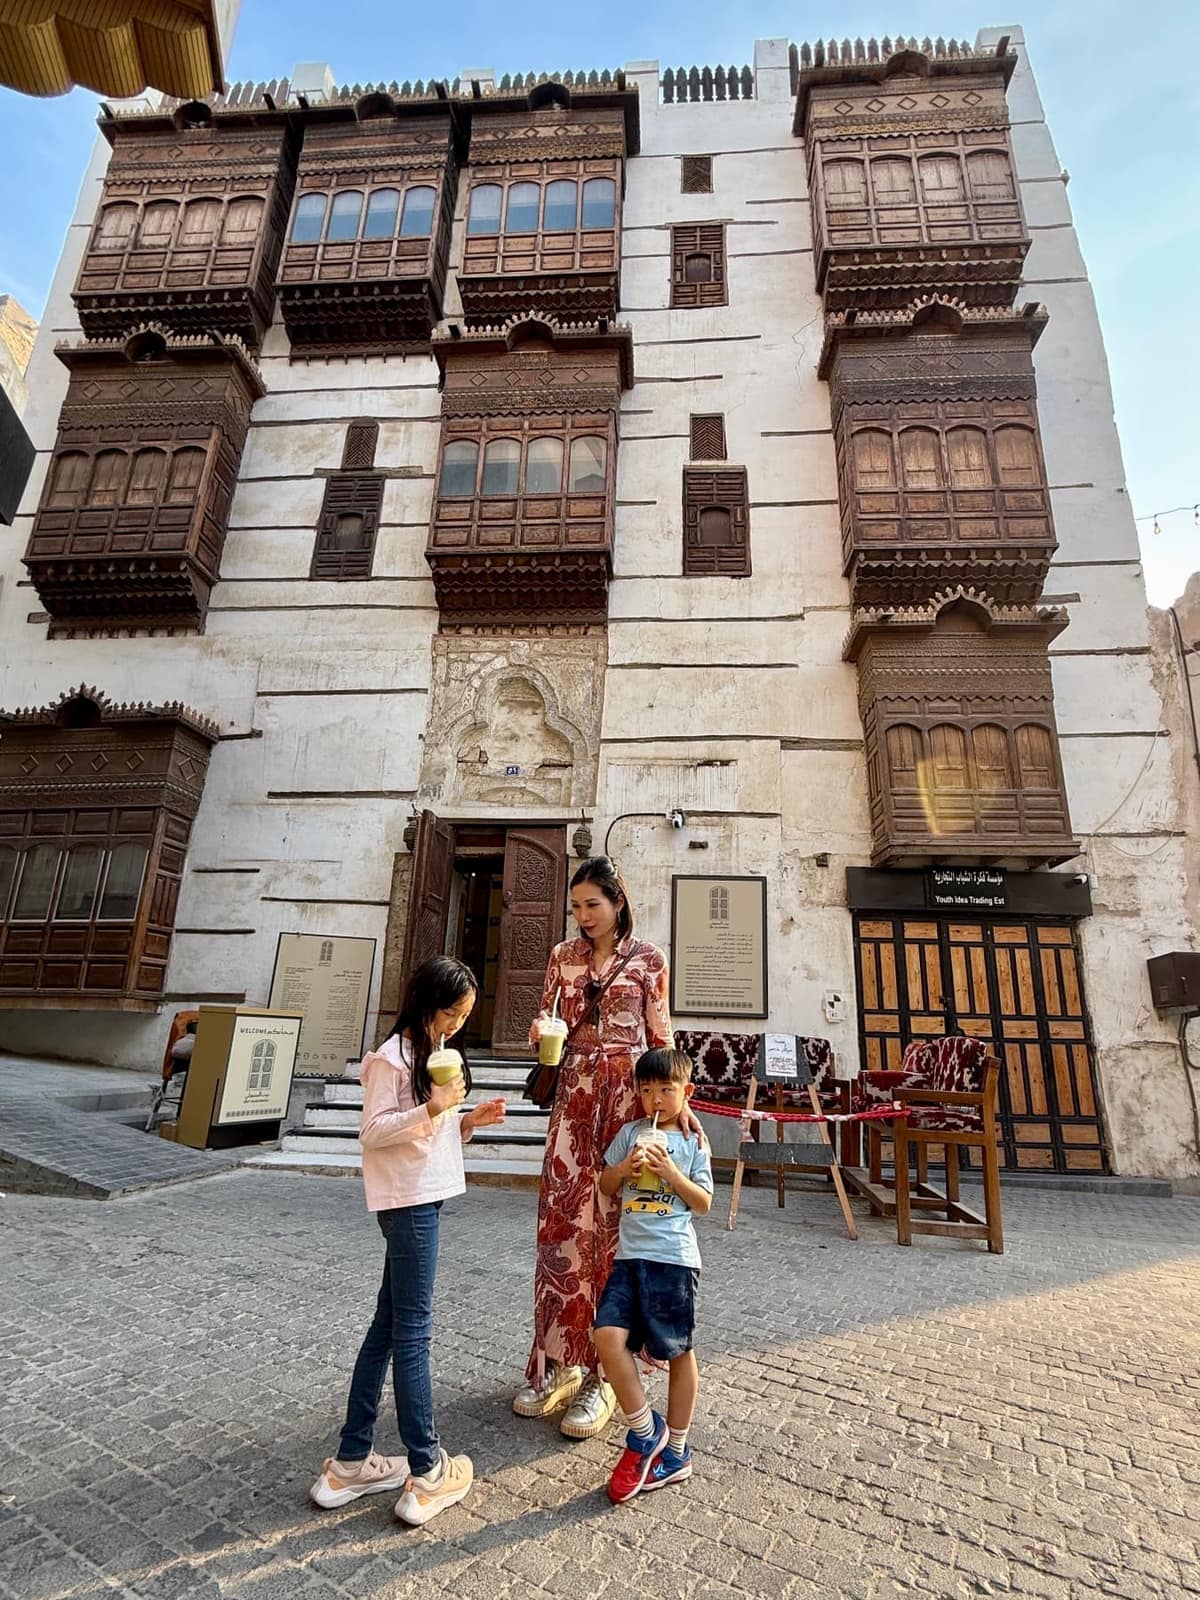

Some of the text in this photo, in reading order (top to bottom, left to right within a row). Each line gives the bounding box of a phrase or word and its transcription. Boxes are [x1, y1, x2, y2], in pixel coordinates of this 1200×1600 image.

[933, 870, 1003, 885] مؤسسة فكرة الشباب التجارية
[935, 895, 1005, 906] Youth Idea Trading Est
